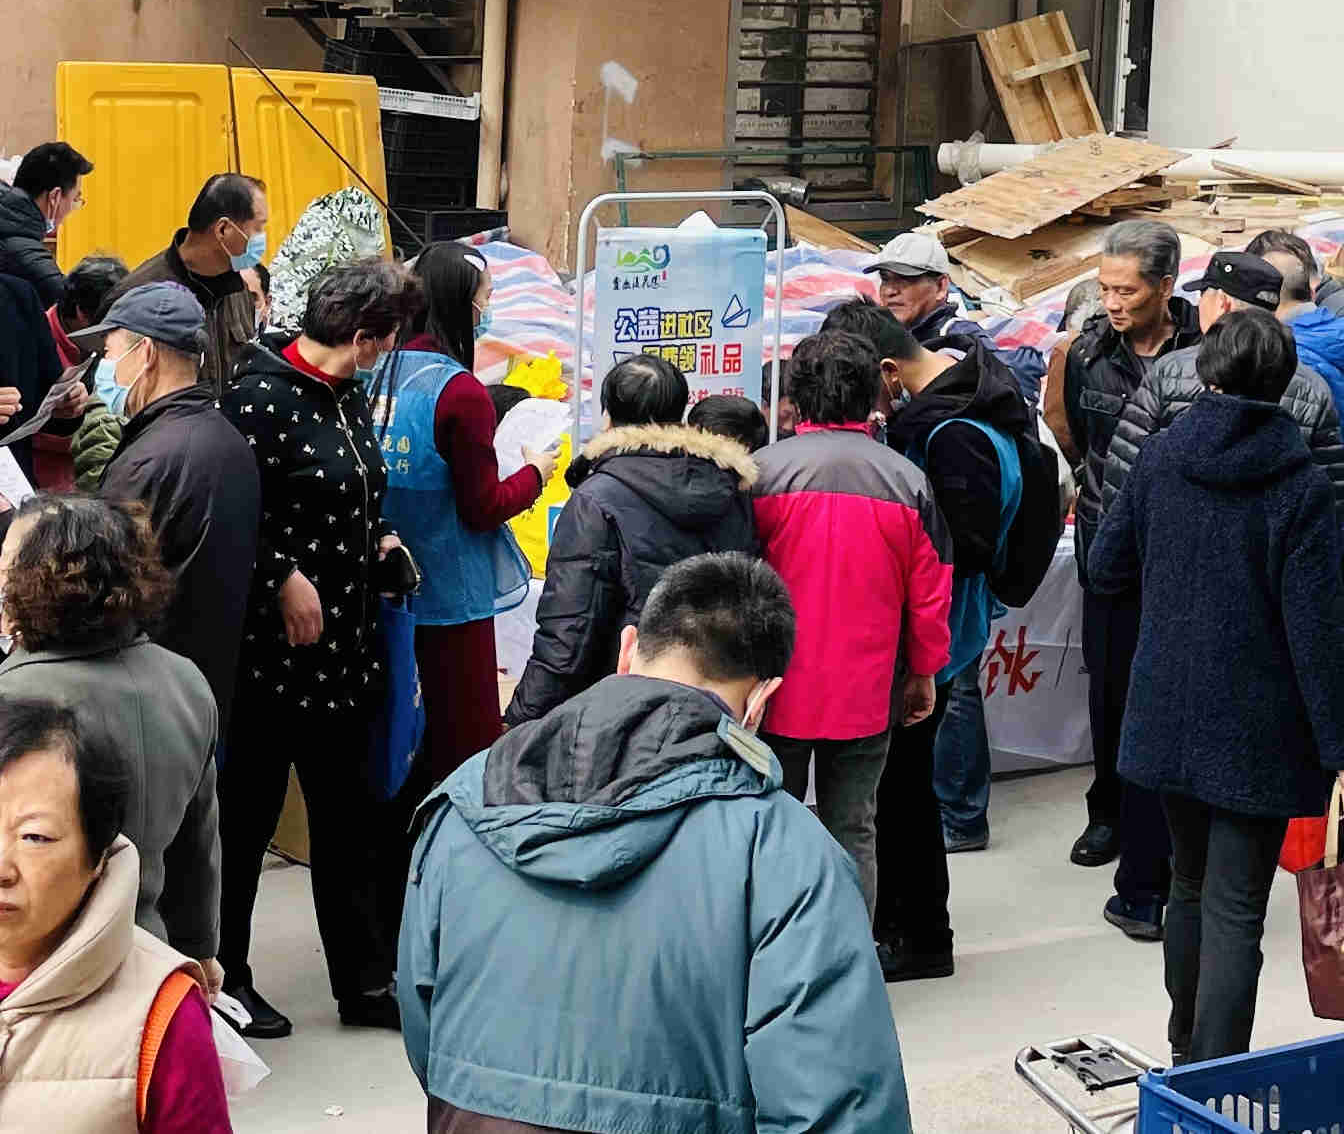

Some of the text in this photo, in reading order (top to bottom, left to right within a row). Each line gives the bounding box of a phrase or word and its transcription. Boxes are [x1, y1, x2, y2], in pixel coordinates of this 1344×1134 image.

[614, 307, 713, 343] 公益进社区
